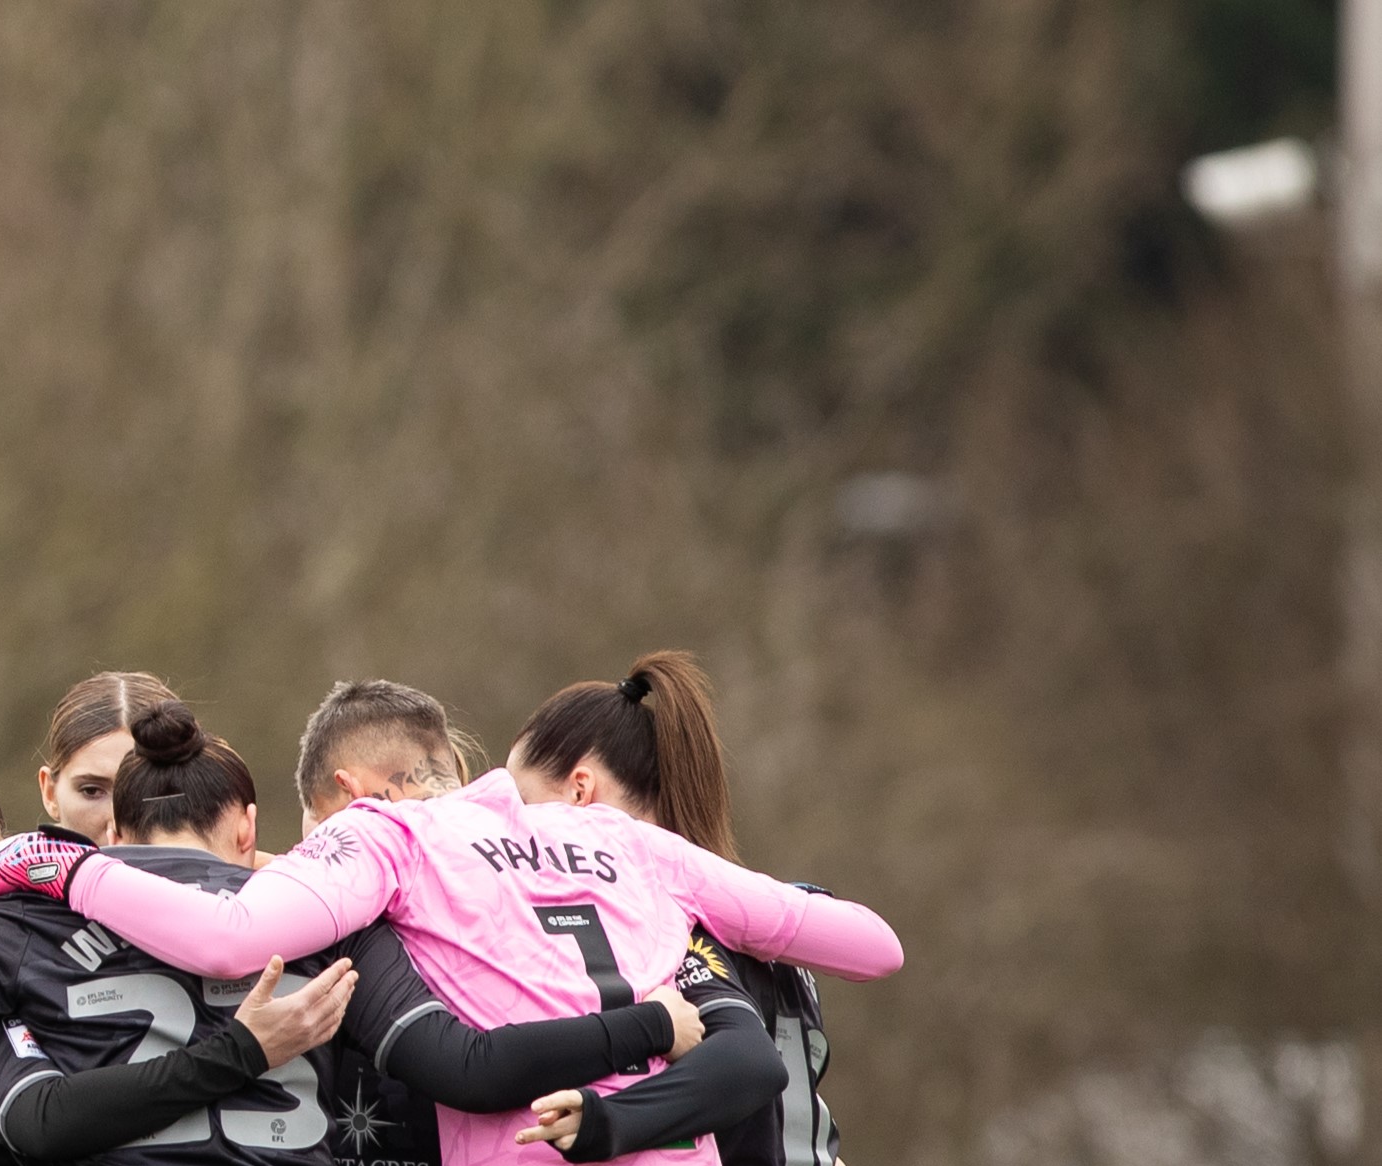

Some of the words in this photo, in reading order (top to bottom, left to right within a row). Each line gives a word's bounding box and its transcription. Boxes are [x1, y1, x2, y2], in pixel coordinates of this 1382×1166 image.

[66, 973, 329, 1149] 23
[532, 904, 649, 1075] 1
[271, 1135, 285, 1143] EFL
